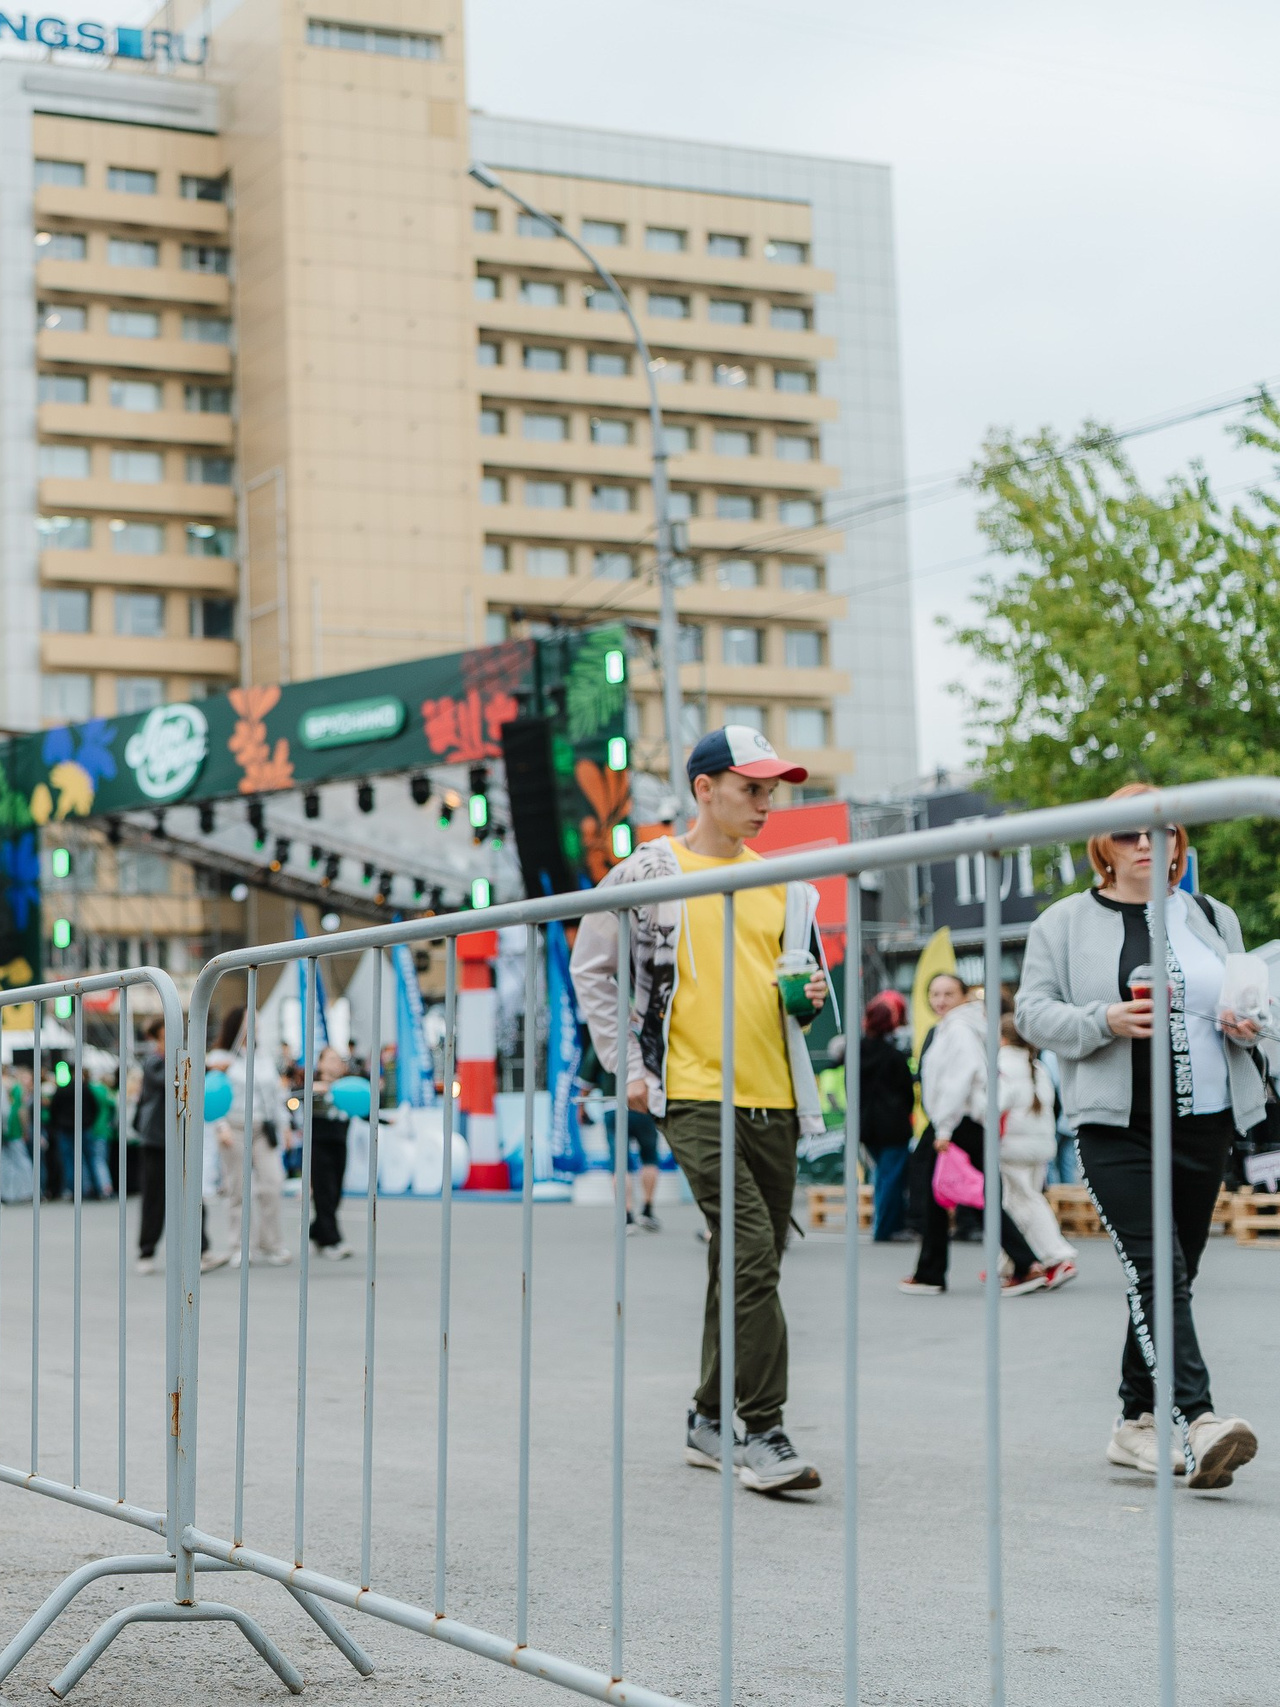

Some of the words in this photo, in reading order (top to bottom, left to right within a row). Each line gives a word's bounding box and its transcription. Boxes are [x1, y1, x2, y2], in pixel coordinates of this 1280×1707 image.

[1169, 1012, 1189, 1053] PARIS
[1173, 1054, 1194, 1095] PARIS
[1125, 1285, 1146, 1325] PARIS
[1135, 1324, 1157, 1367] PARIS
